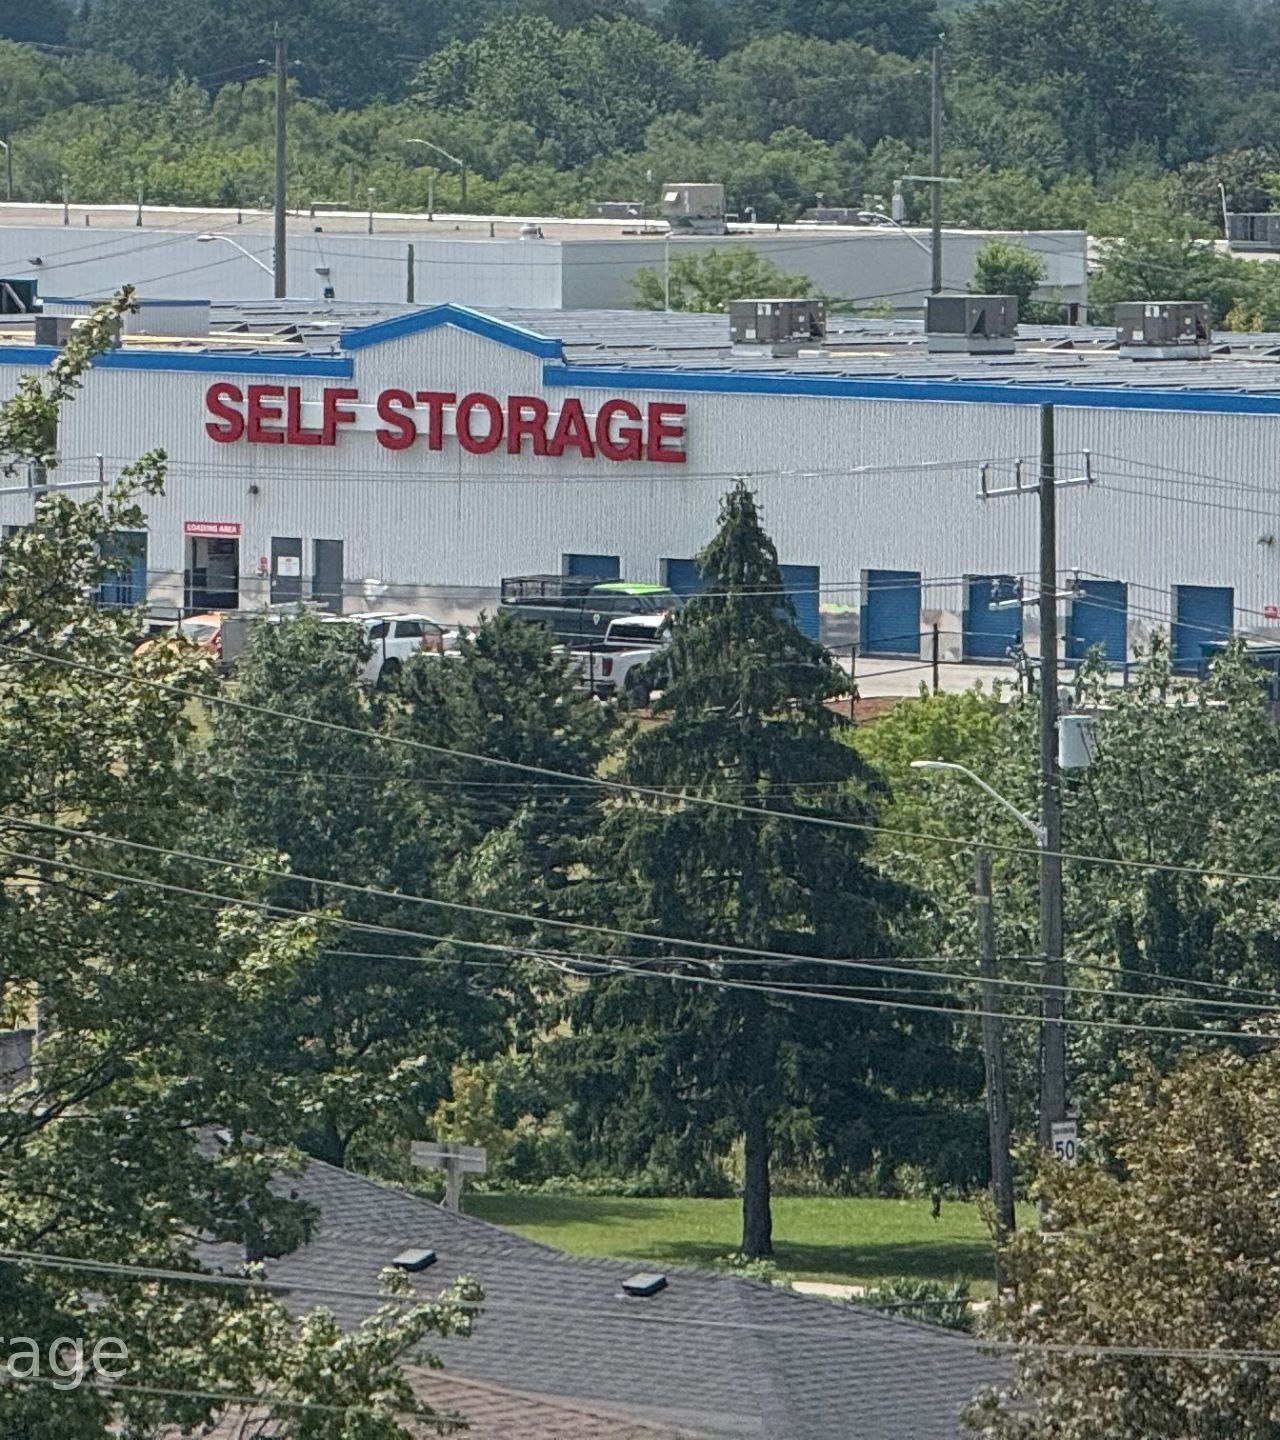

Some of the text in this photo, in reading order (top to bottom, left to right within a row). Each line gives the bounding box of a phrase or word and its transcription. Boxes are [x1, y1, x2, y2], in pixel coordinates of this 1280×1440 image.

[205, 382, 687, 463] SELF STORAGE
[1055, 1140, 1075, 1160] 50
